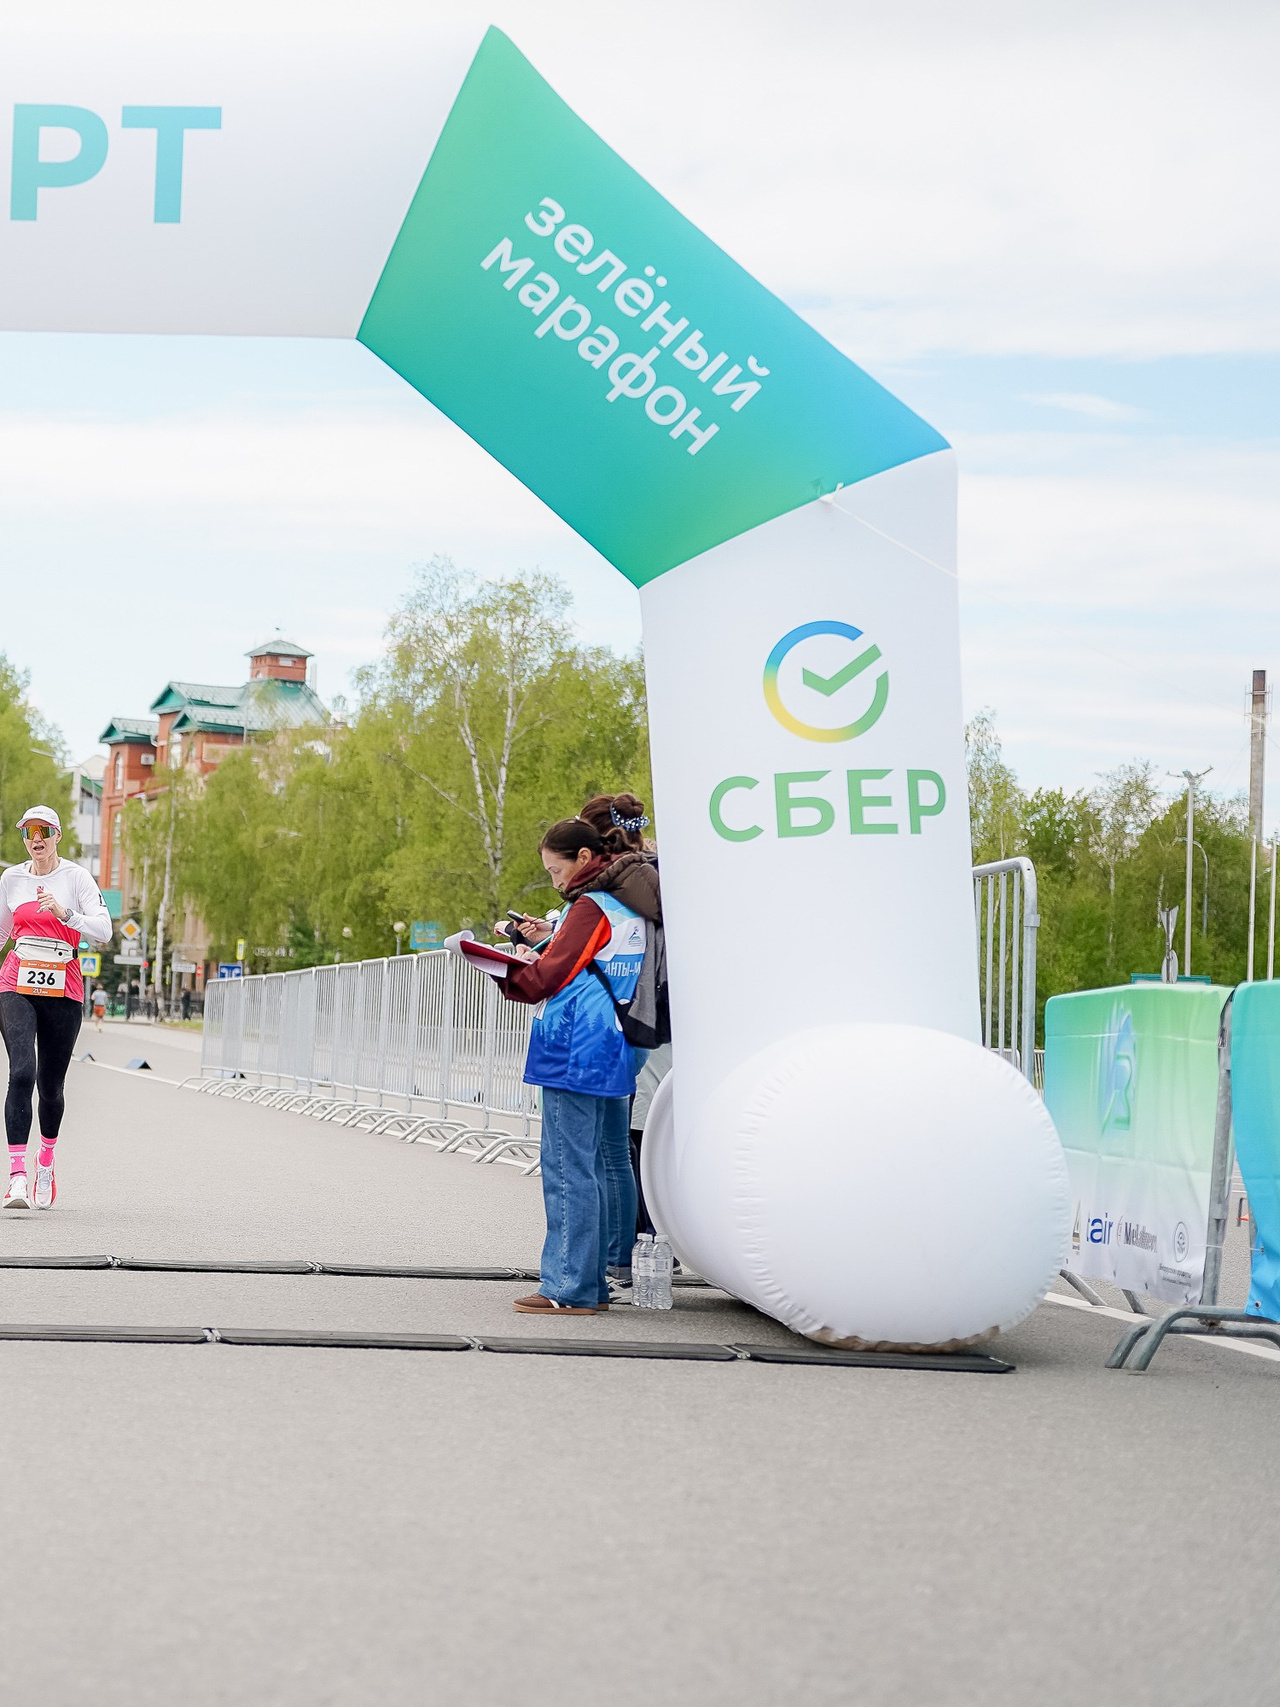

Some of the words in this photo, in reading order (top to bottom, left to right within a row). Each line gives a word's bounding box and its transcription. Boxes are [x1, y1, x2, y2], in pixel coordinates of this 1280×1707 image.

[479, 236, 721, 456] марафон
[524, 196, 771, 413] зелёный
[709, 768, 946, 843] СБЕР
[27, 970, 55, 986] 236
